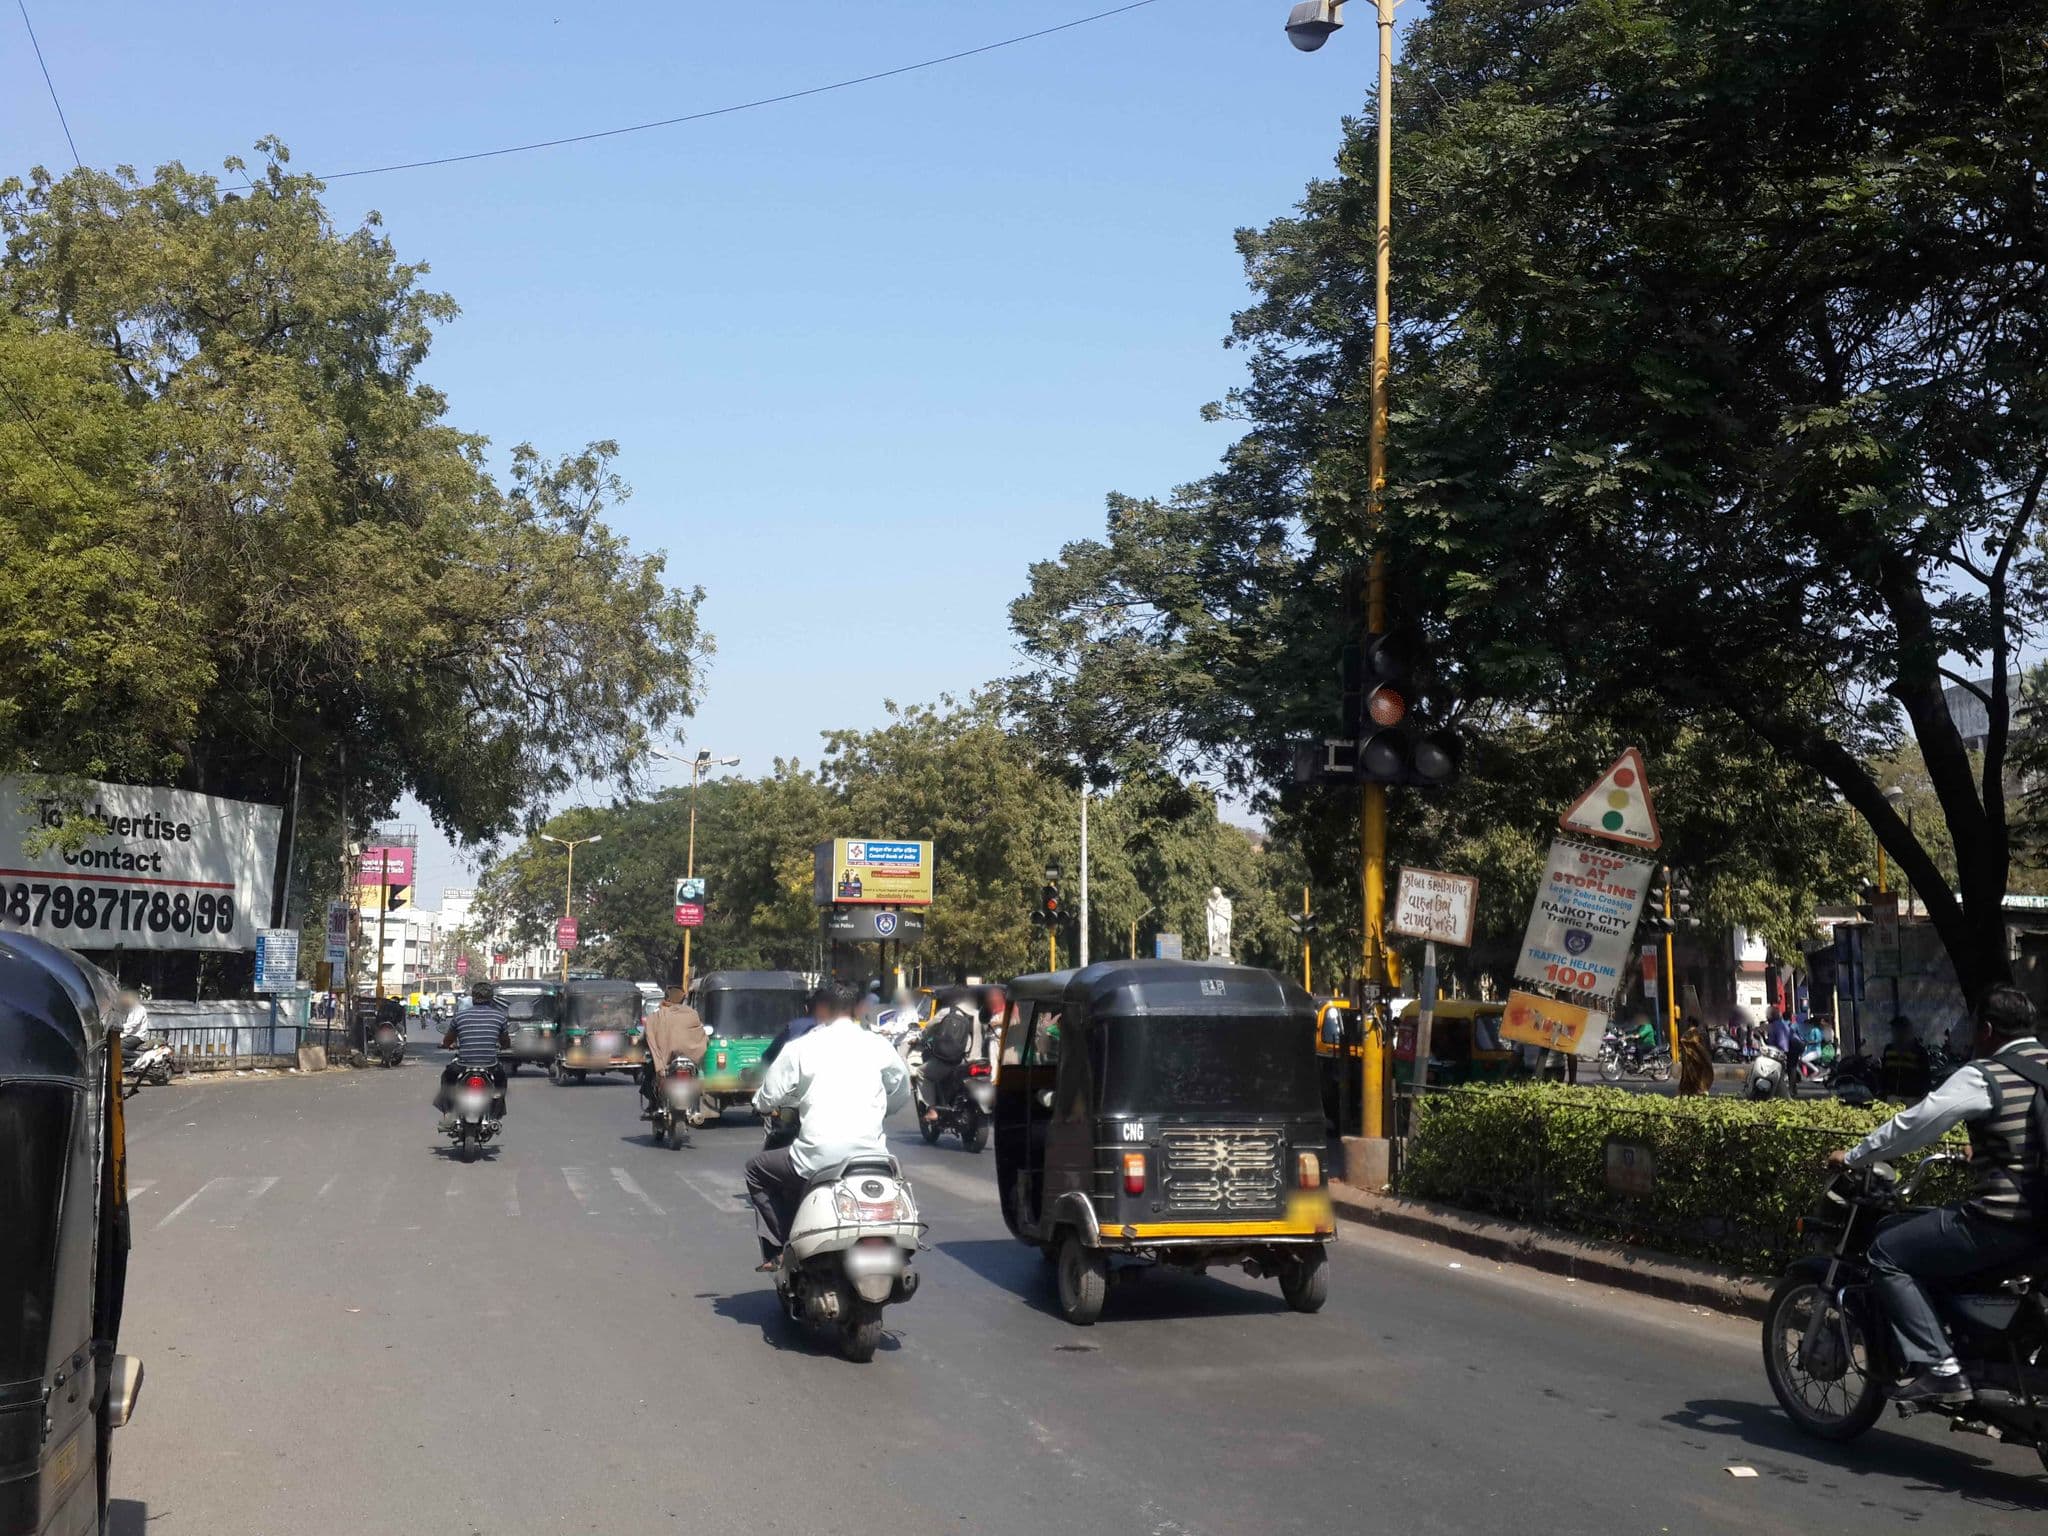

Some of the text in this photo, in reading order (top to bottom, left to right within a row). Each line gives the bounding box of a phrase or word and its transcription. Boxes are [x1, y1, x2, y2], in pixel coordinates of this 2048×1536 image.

[1579, 852, 1625, 870] STOP
[1587, 867, 1609, 880] AT
[1549, 883, 1632, 911] Leave Zebra Crossing
[1553, 871, 1638, 900] STOPLINE
[1540, 901, 1631, 930] RAJKOT CITY
[1573, 898, 1618, 915] Pedestrians
[1547, 912, 1620, 936] Traffic Police
[1528, 949, 1616, 977] TRAFFIC HELPLINE
[1544, 963, 1597, 990] 100
[1123, 1123, 1144, 1142] CNG
